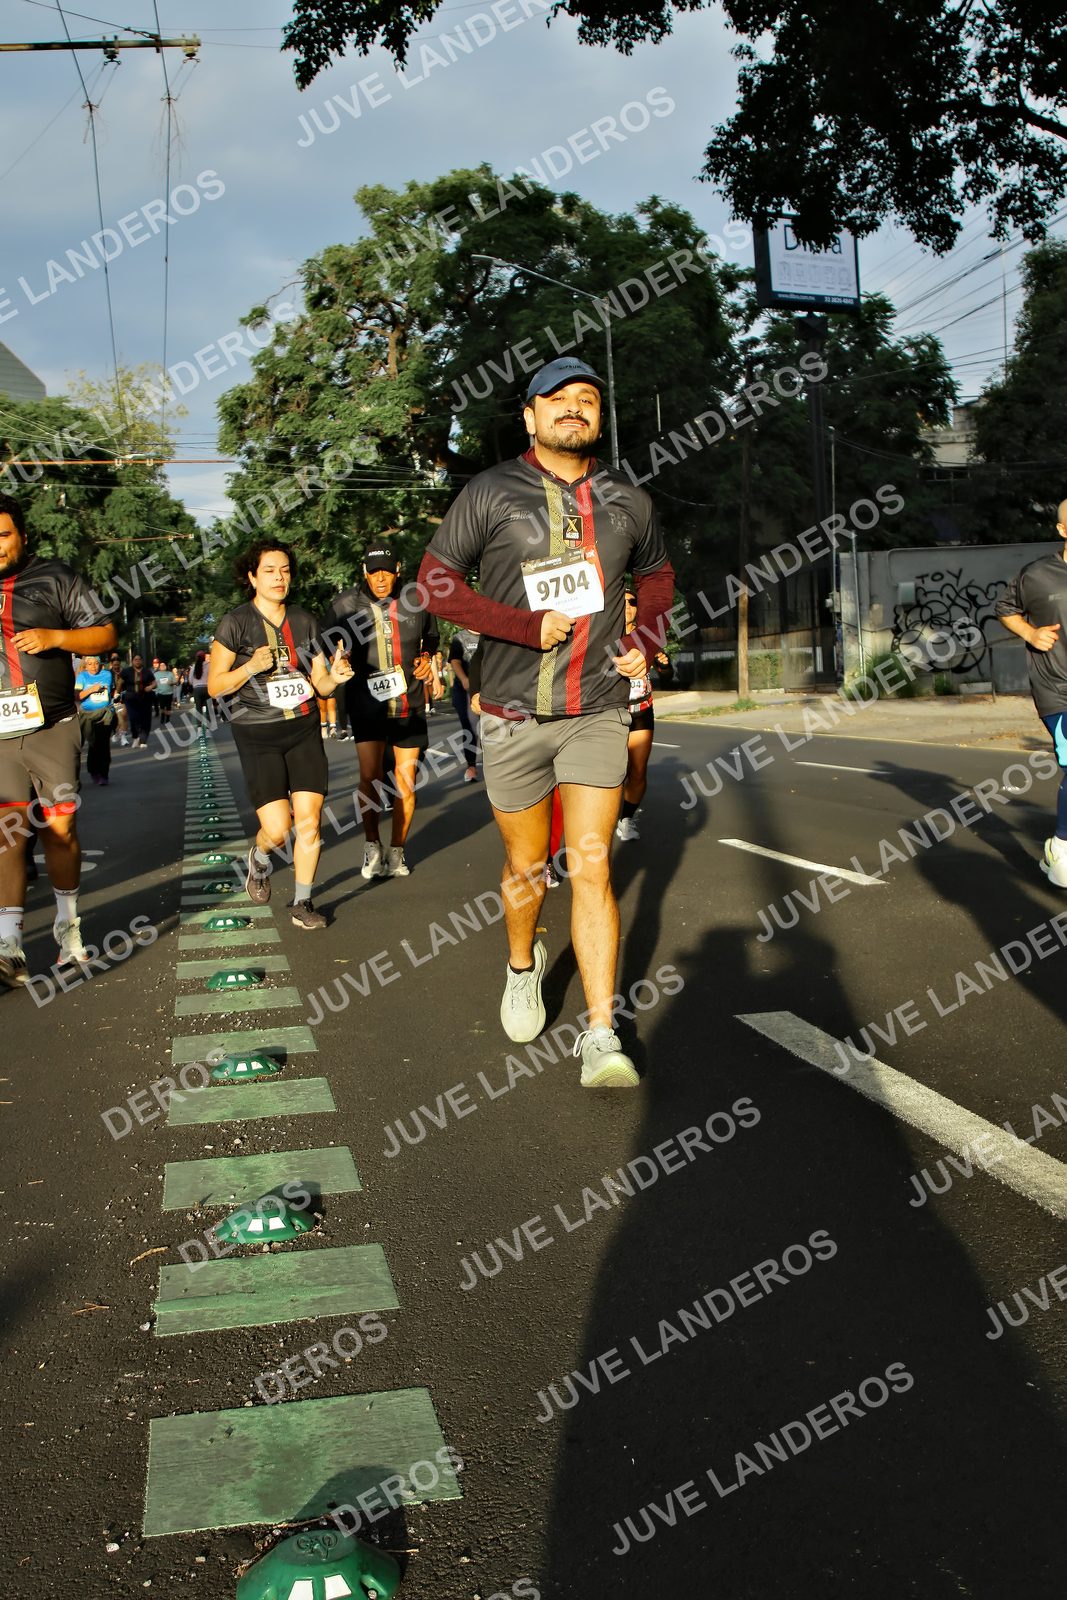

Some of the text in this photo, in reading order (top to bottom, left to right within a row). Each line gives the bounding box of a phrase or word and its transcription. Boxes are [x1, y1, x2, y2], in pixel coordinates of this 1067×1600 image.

[536, 569, 590, 602] 9704
[915, 568, 963, 587] TOY
[274, 683, 305, 699] 3528
[372, 677, 397, 692] 4421
[0, 700, 29, 717] 845
